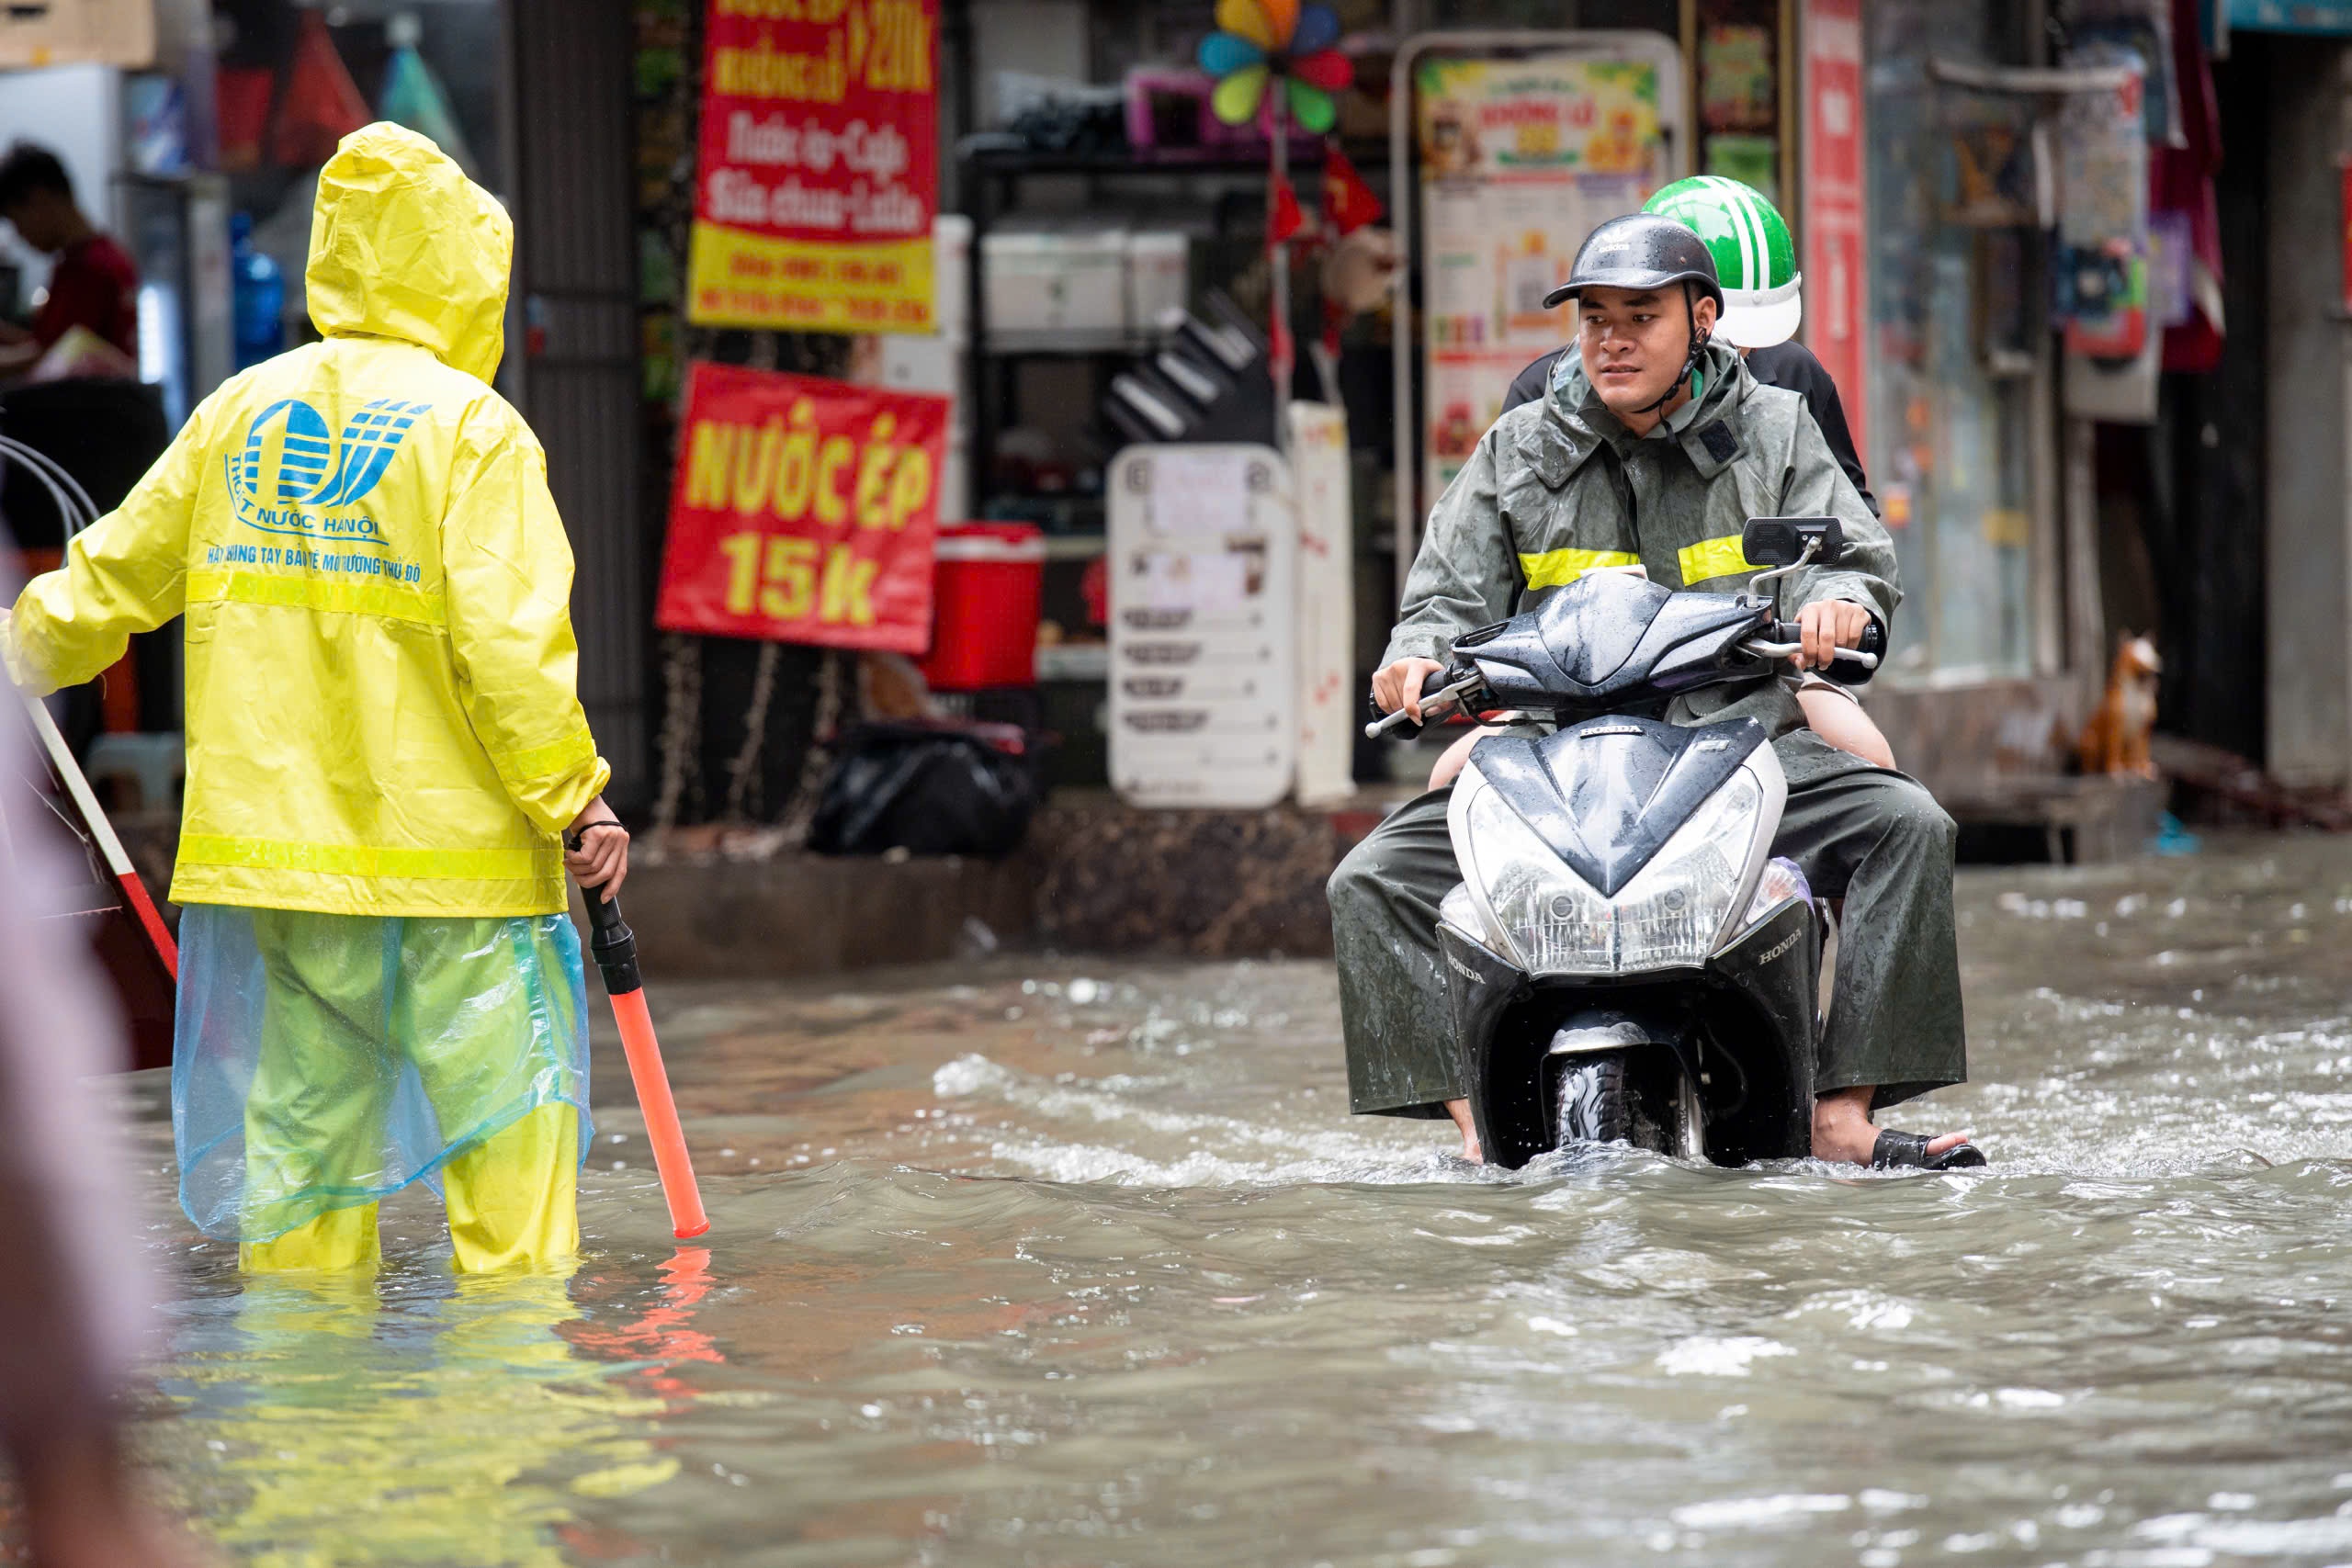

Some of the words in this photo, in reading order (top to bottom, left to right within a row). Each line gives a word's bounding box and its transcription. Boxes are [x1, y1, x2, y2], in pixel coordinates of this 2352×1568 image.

[685, 398, 854, 525] NƯỚC
[855, 412, 931, 531] ÉP
[256, 508, 316, 529] NƯỚC
[261, 547, 282, 566] TAY
[383, 557, 402, 580] THỦ
[404, 562, 421, 583] ĐÔ
[1579, 725, 1643, 736] HONDA
[1758, 928, 1802, 965] HONDA
[1447, 950, 1487, 985] HONDA
